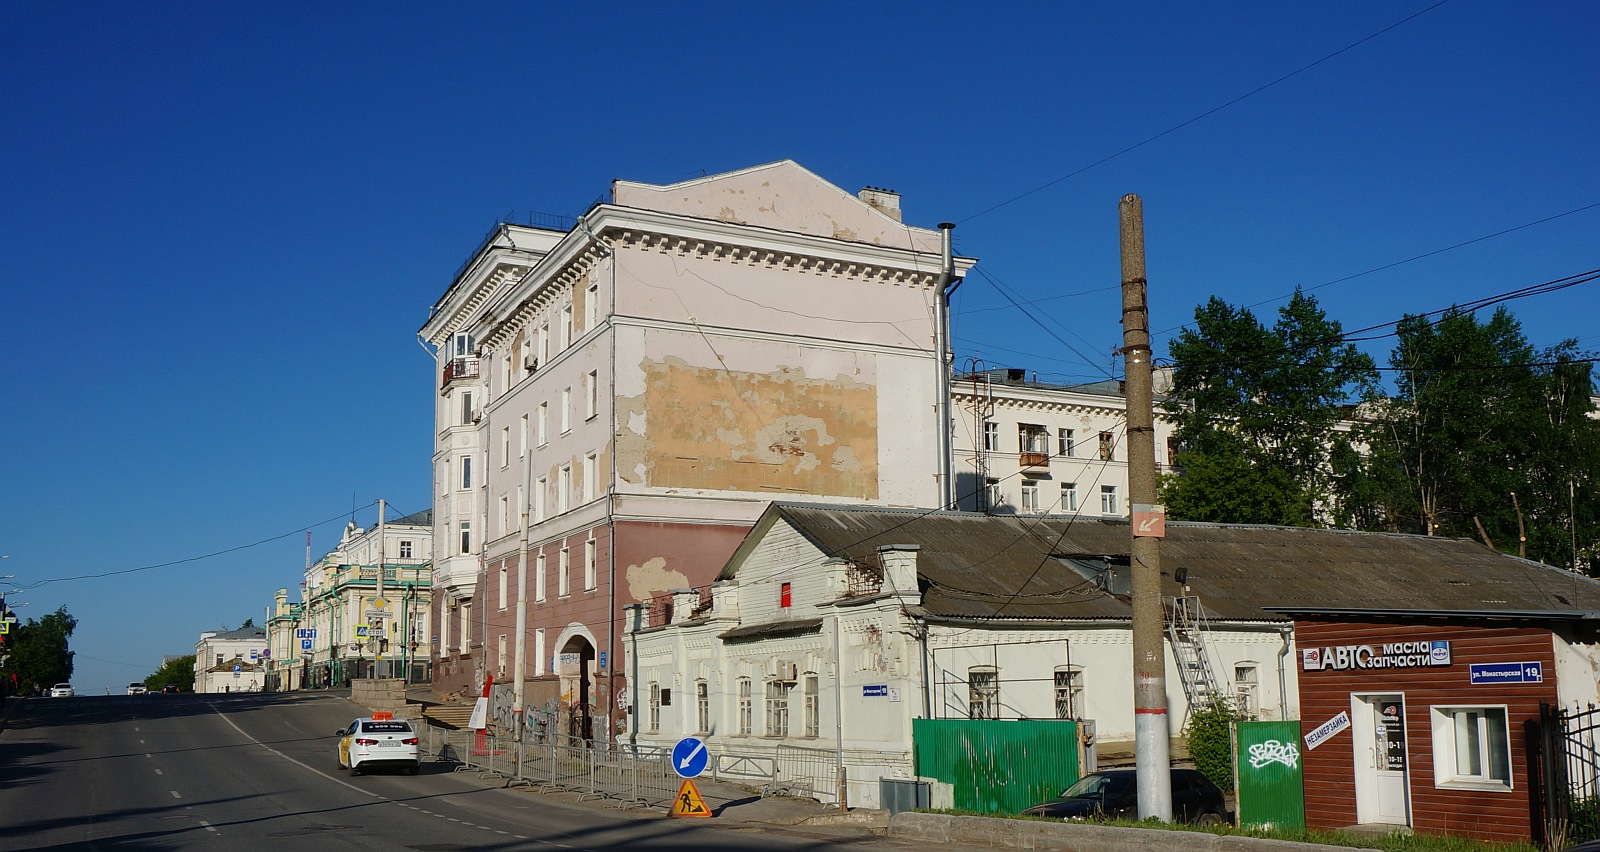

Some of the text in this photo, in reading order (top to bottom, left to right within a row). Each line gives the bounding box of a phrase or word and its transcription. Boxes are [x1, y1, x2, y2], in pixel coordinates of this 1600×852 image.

[1383, 641, 1429, 655] масла
[1321, 645, 1374, 669] АВТО
[1367, 654, 1431, 669] запчасти
[1482, 670, 1521, 678] Монастырская
[1306, 714, 1347, 746] НЕЗАМЕРЗАЙКА
